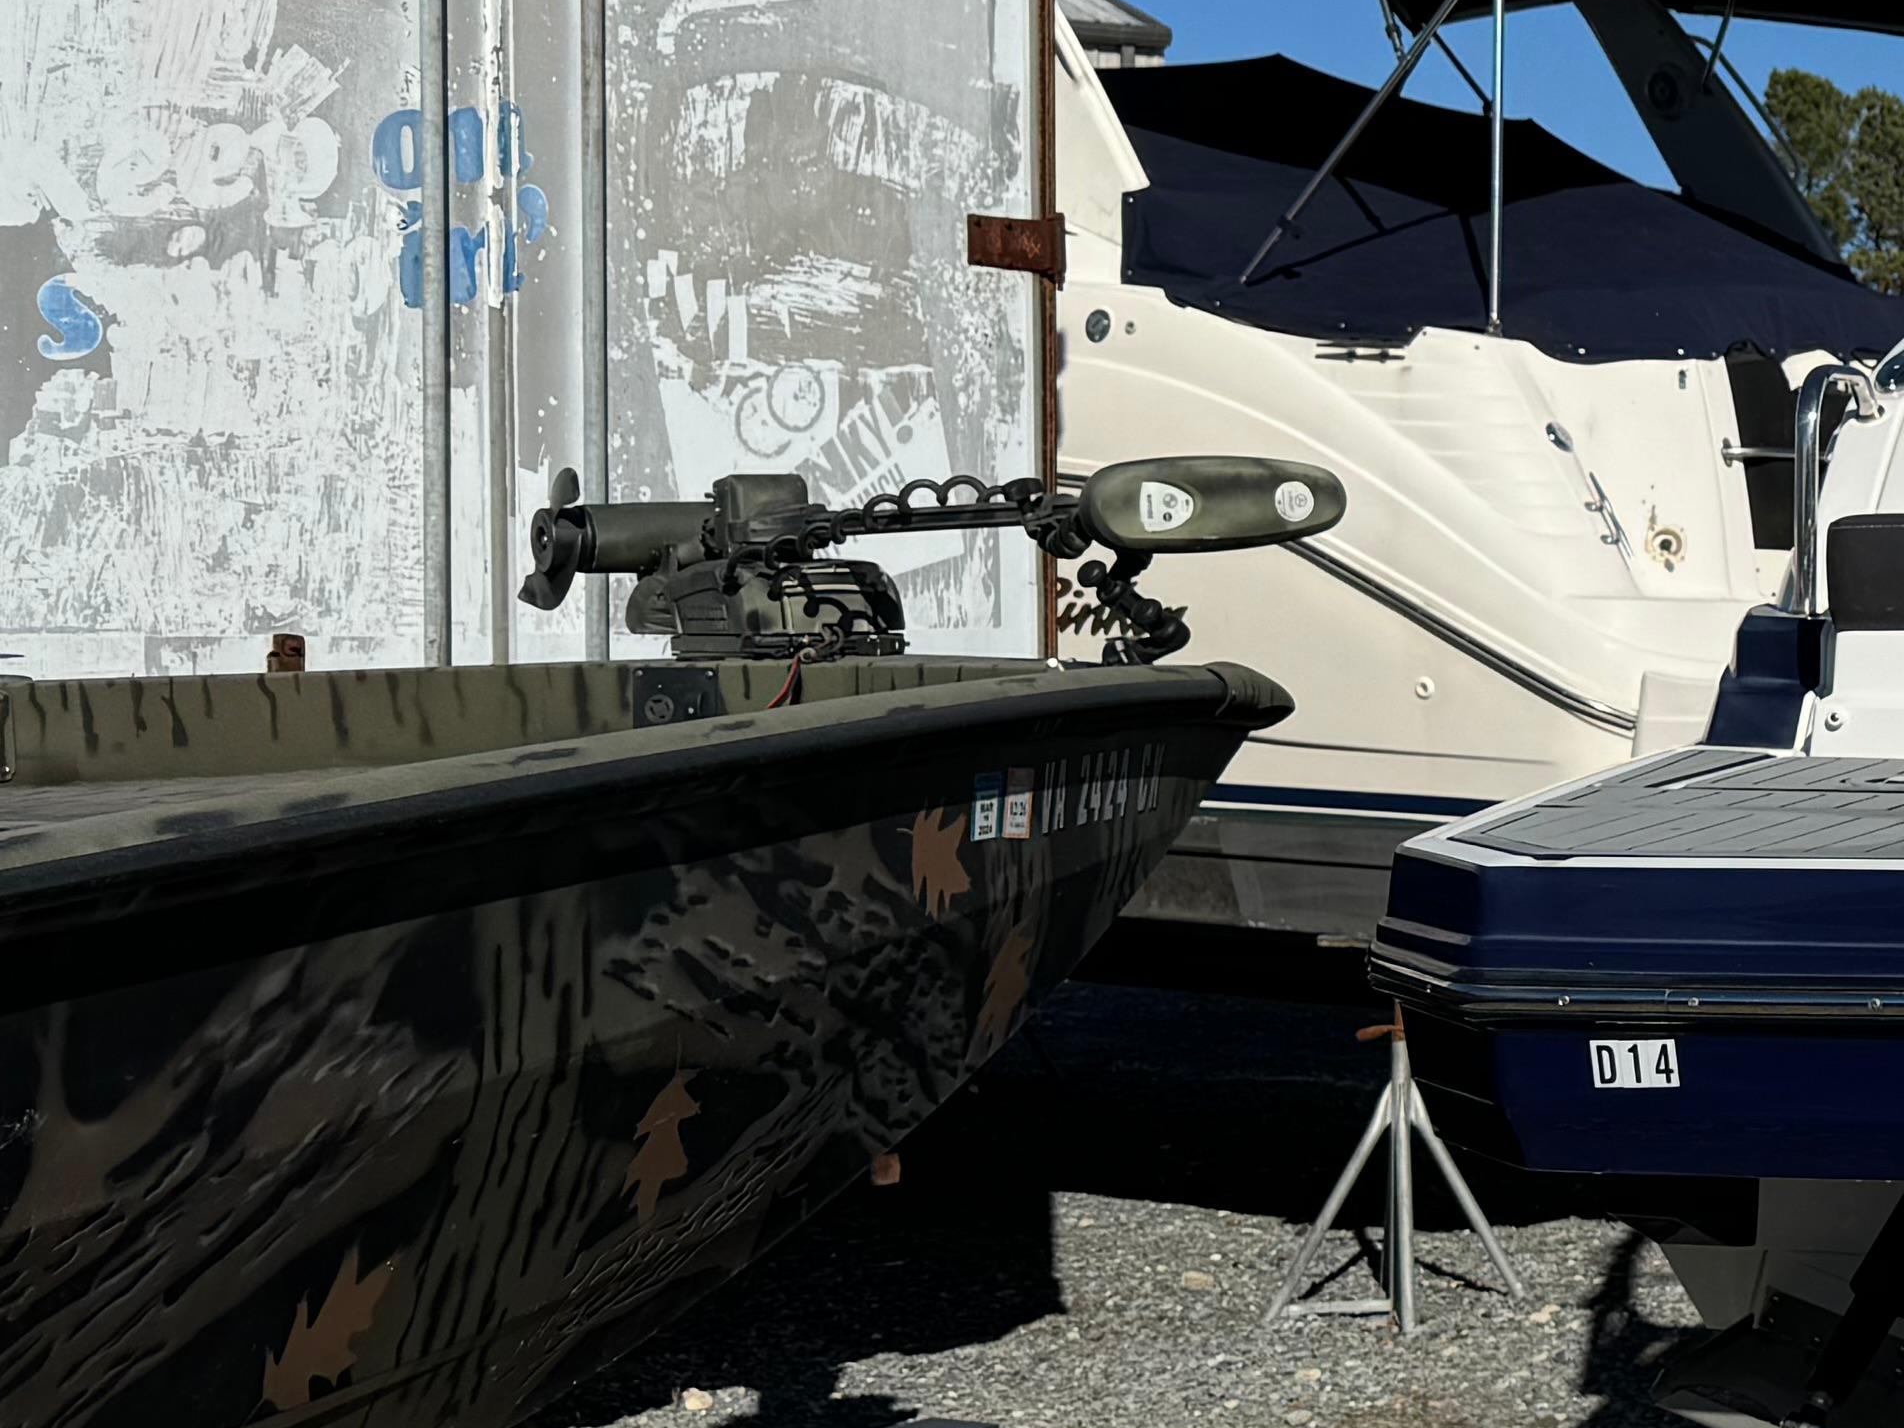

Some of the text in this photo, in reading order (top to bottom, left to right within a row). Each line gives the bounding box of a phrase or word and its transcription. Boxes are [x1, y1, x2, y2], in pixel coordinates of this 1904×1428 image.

[1041, 758, 1068, 835] VA
[1076, 748, 1130, 826] 2424
[1595, 1044, 1674, 1084] D14
